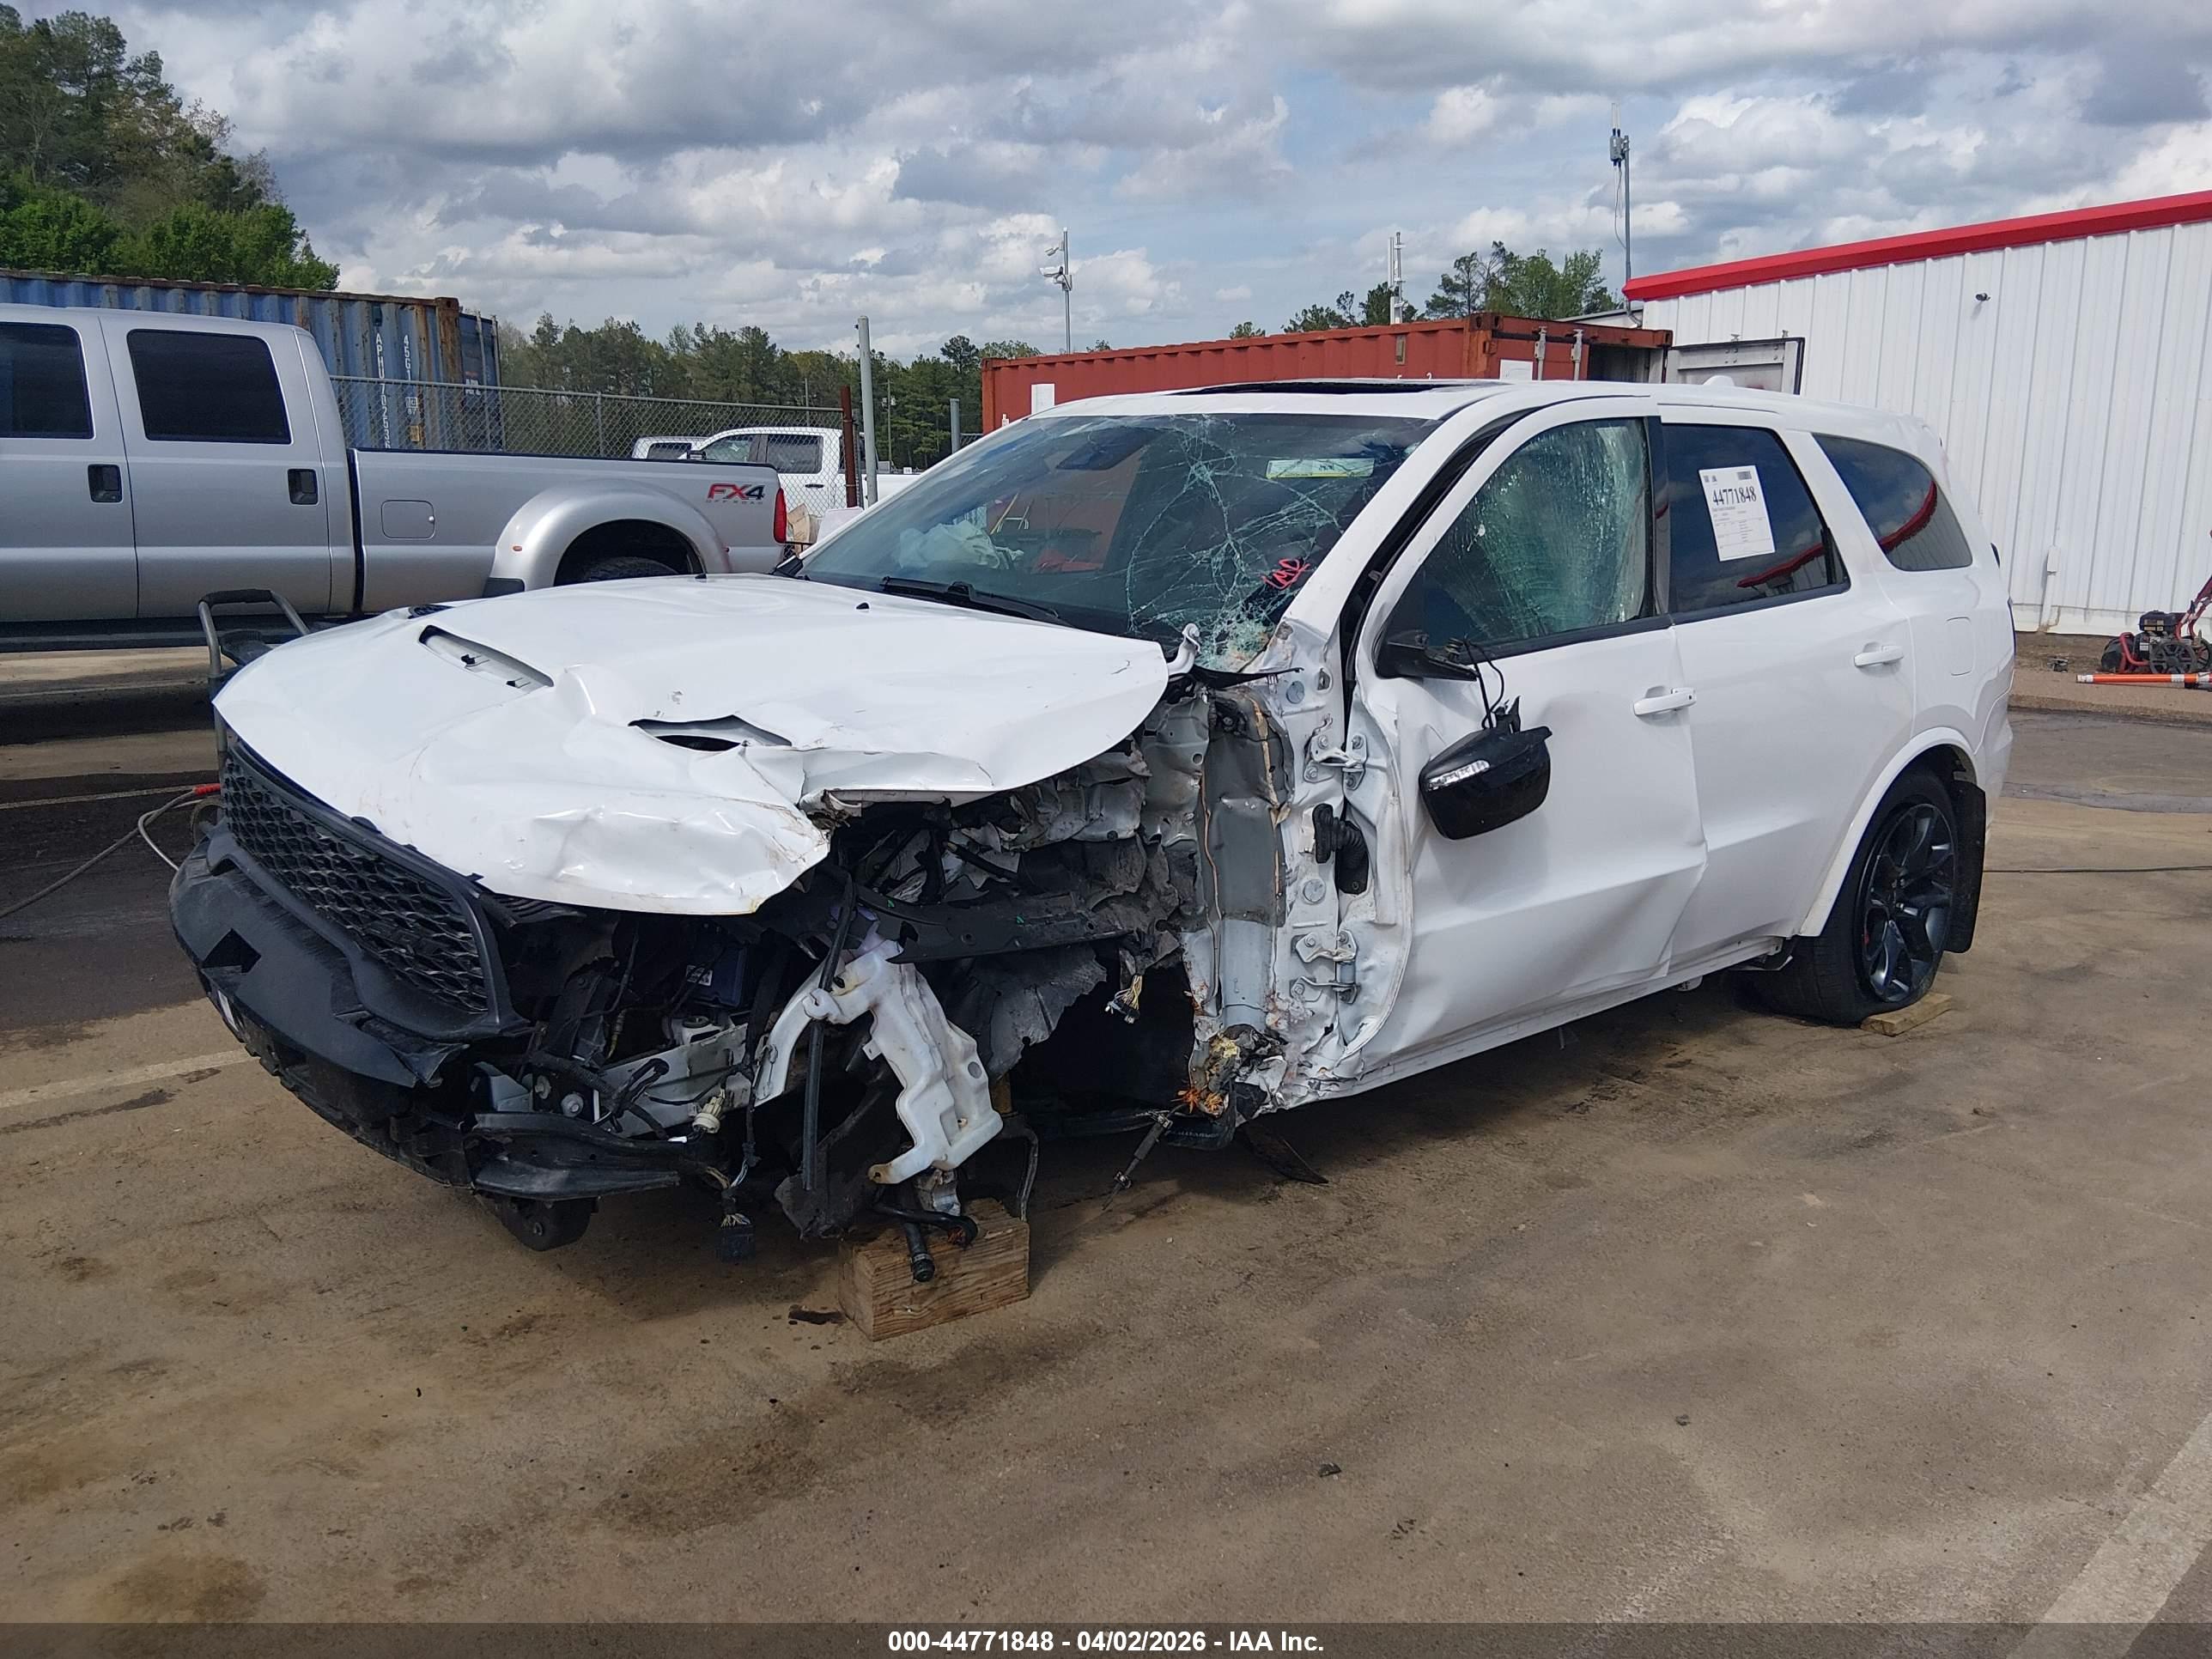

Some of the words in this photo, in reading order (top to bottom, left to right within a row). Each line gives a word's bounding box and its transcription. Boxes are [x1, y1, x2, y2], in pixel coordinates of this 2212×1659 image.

[376, 333, 385, 379] APHU
[707, 483, 765, 500] FX4
[1712, 486, 1757, 506] 44771848
